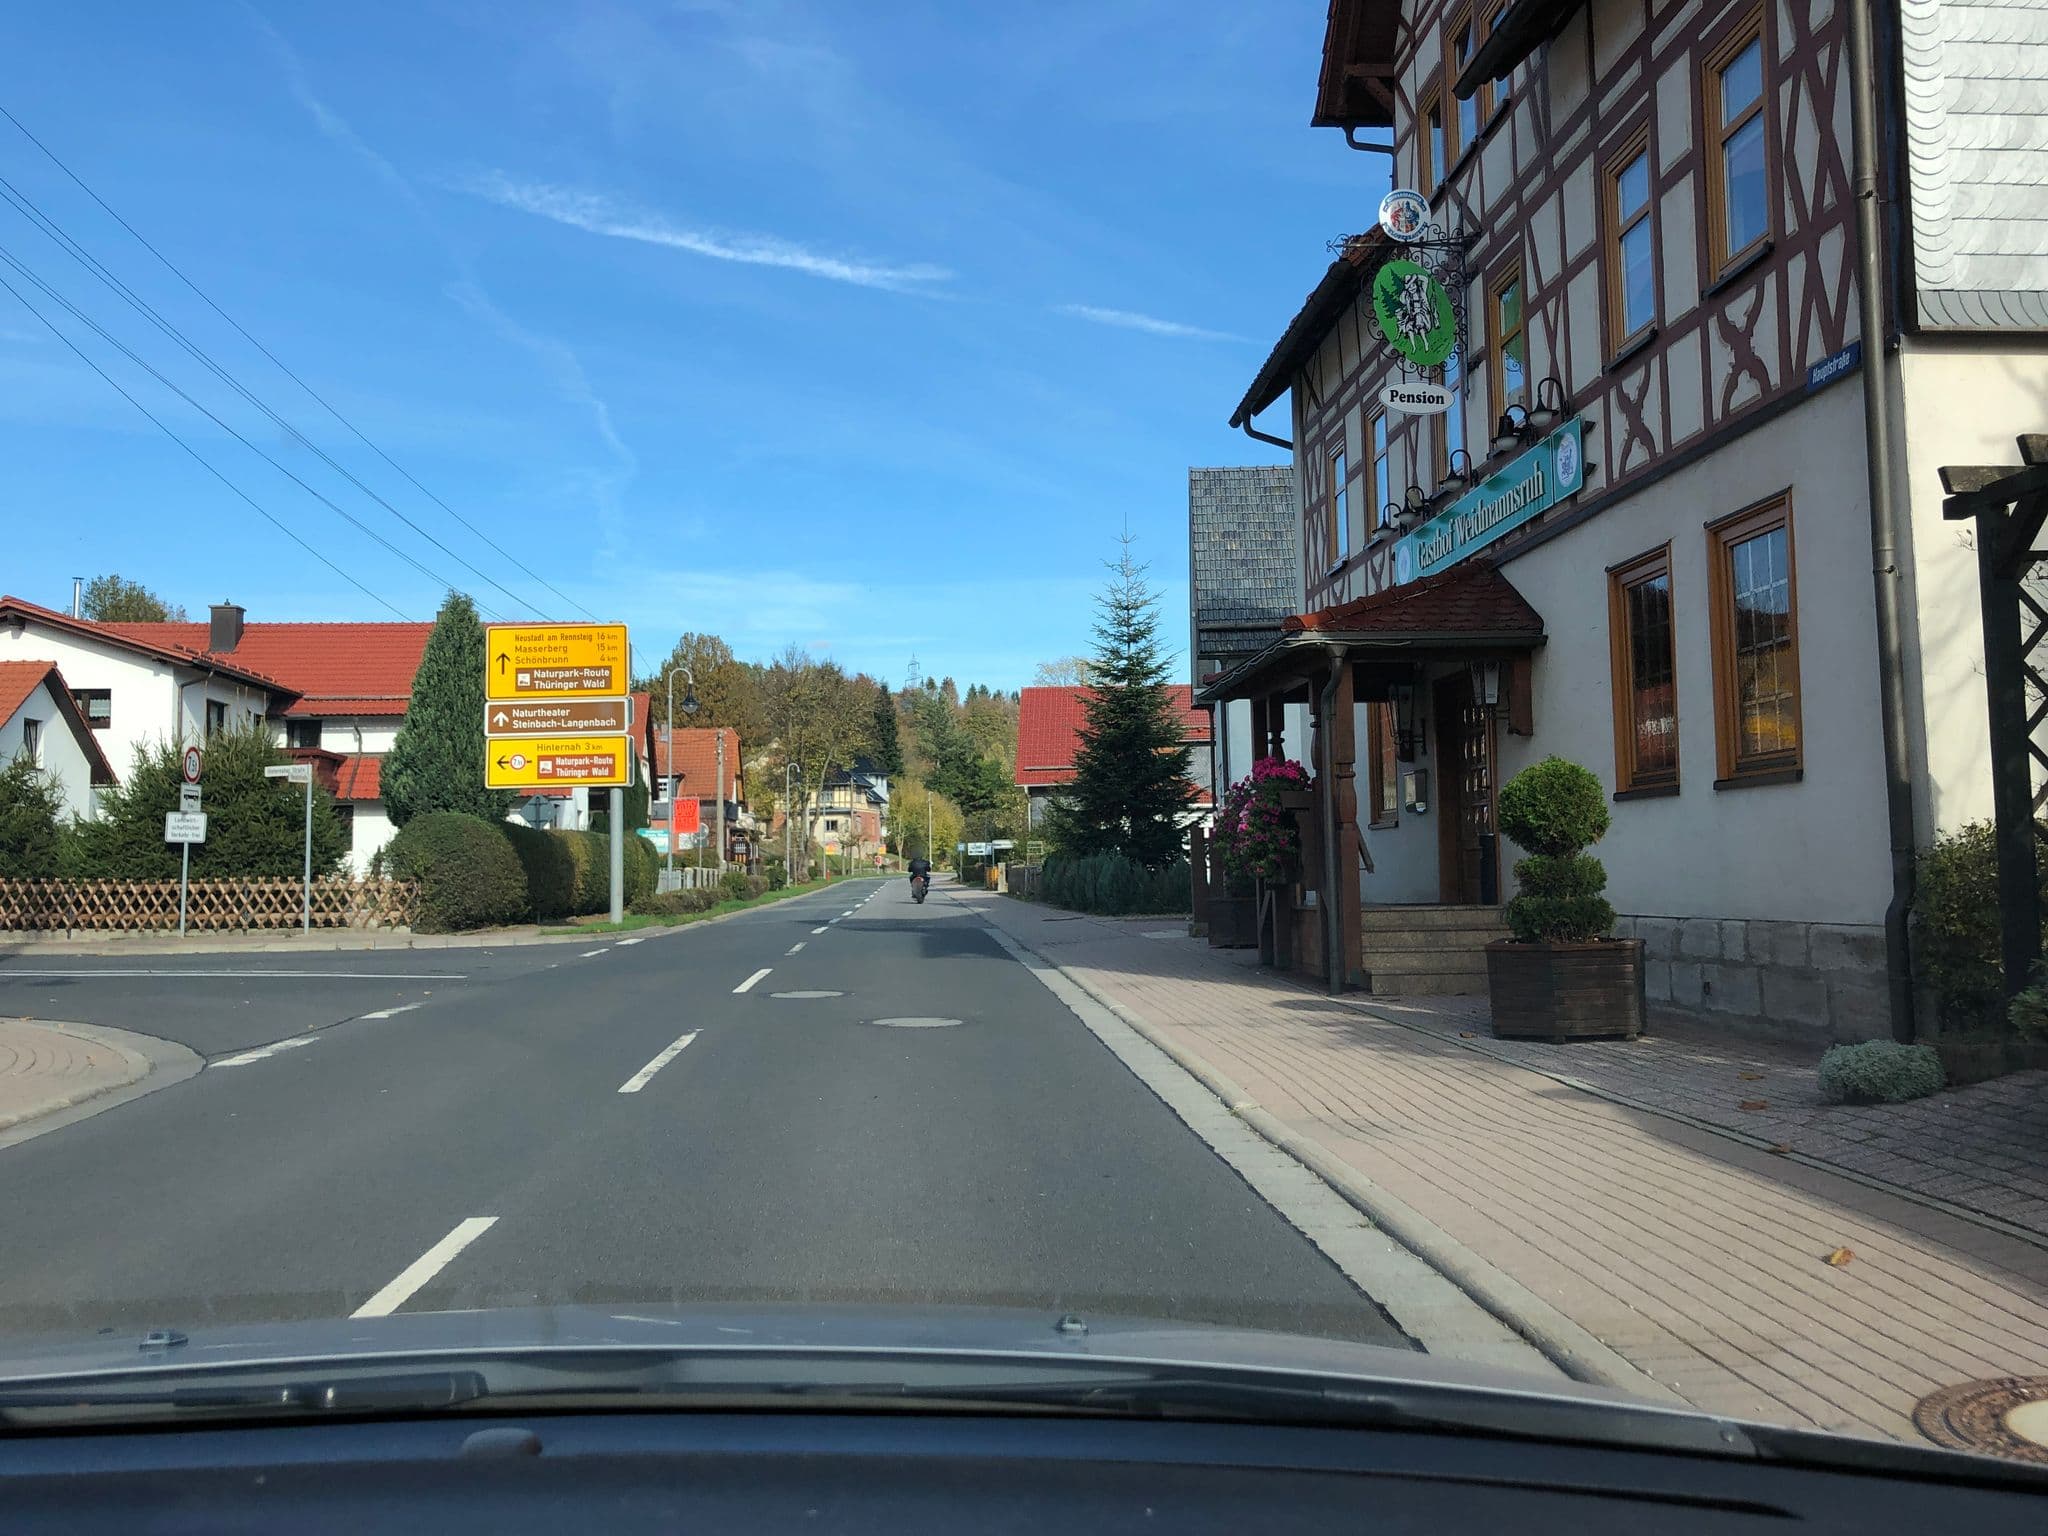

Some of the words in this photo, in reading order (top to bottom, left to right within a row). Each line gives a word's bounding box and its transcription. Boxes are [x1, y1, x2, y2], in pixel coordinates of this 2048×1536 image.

[1812, 351, 1850, 384] Hauptstraße
[1389, 389, 1445, 405] Pension
[1417, 518, 1455, 570] Gasthof
[1455, 460, 1545, 545] Weidmannsruh
[515, 634, 544, 642] Neustadt
[560, 633, 593, 642] Rennsteig
[597, 632, 605, 640] 16
[515, 644, 568, 653] Masserberg
[597, 643, 605, 651] 15
[515, 655, 569, 665] Schönbrunn
[599, 654, 605, 662] 4
[533, 668, 610, 679] Naturpark-Route
[533, 680, 578, 691] Thüringer
[582, 679, 605, 689] Wald
[512, 708, 571, 718] Naturtheater
[512, 718, 616, 729] Steinbach-Langenbach
[537, 743, 581, 752] Hinternah
[585, 742, 591, 751] 3
[592, 743, 602, 751] km
[555, 756, 613, 767] Naturpark-Route
[556, 768, 588, 778] Thüringer
[592, 767, 609, 777] Wald
